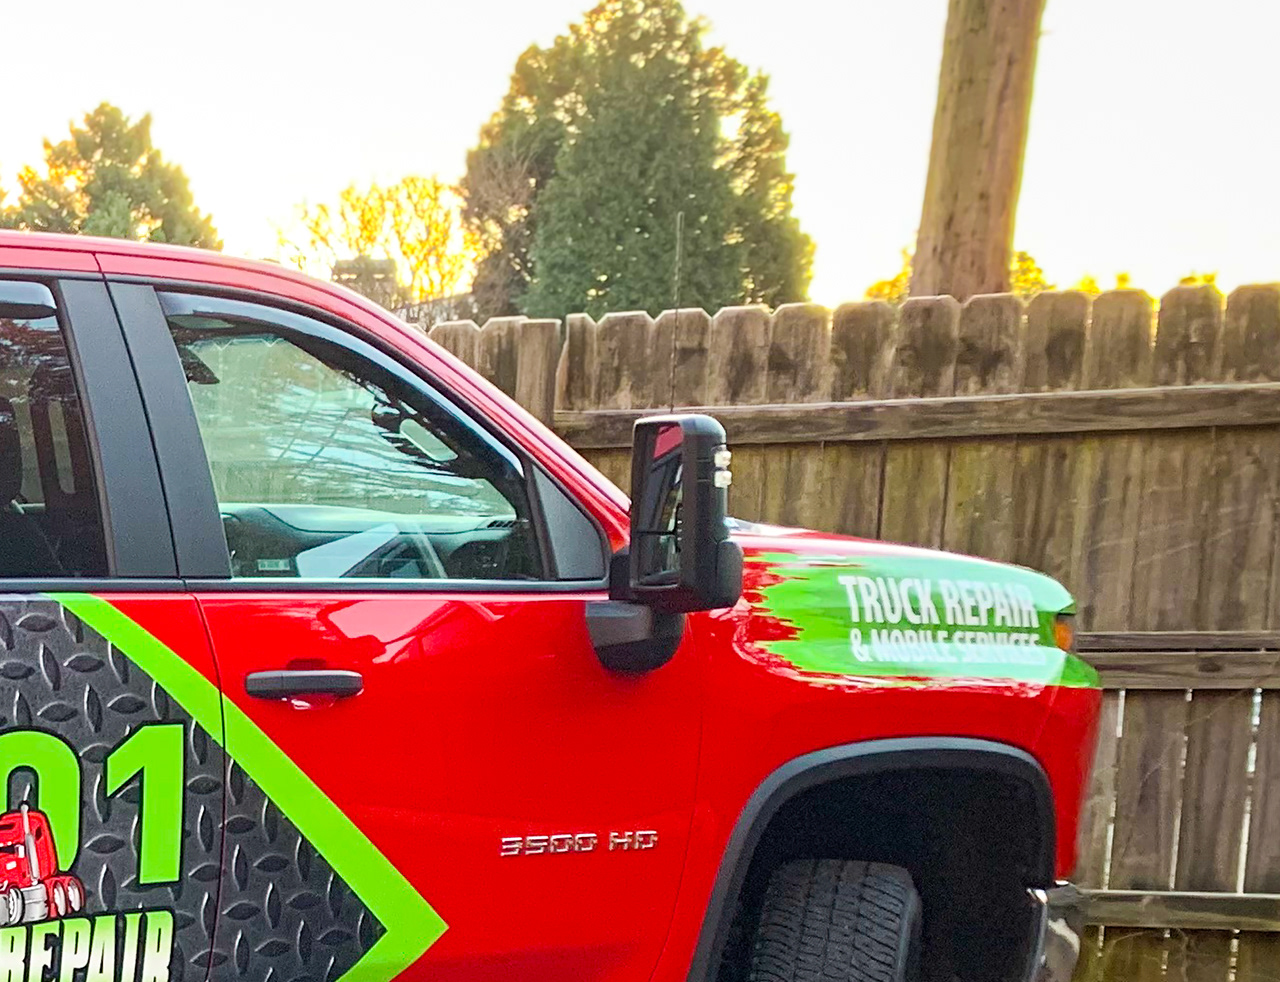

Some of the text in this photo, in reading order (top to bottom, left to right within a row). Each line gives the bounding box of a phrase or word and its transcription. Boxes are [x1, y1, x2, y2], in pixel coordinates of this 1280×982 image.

[838, 575, 1039, 628] TRUCK REPAIR
[849, 627, 1047, 664] & MOBILE SERVICES
[500, 830, 659, 857] 3500 HD
